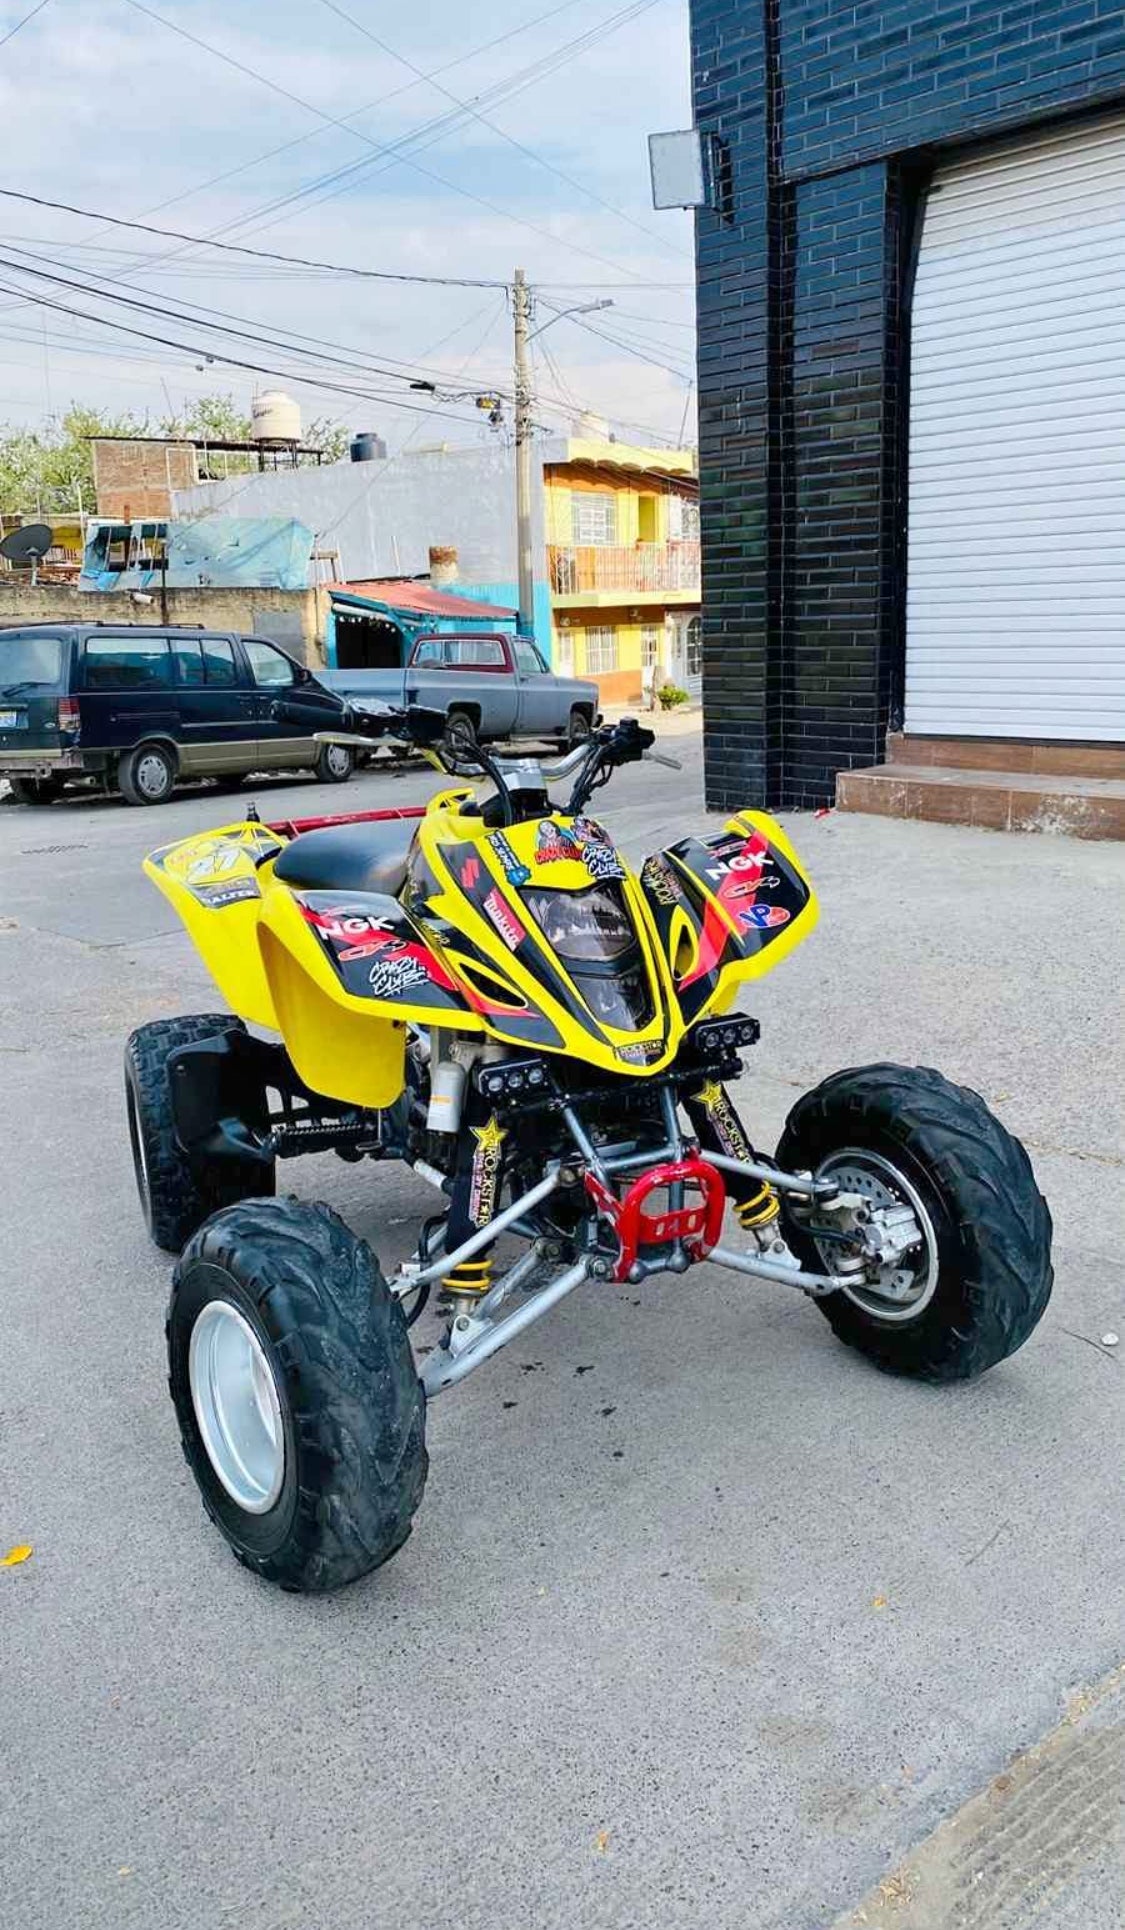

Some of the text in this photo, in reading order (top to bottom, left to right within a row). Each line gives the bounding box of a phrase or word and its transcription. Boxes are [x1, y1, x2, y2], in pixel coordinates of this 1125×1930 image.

[705, 850, 774, 880] NGK
[739, 904, 772, 927] VP
[316, 916, 395, 940] NGK
